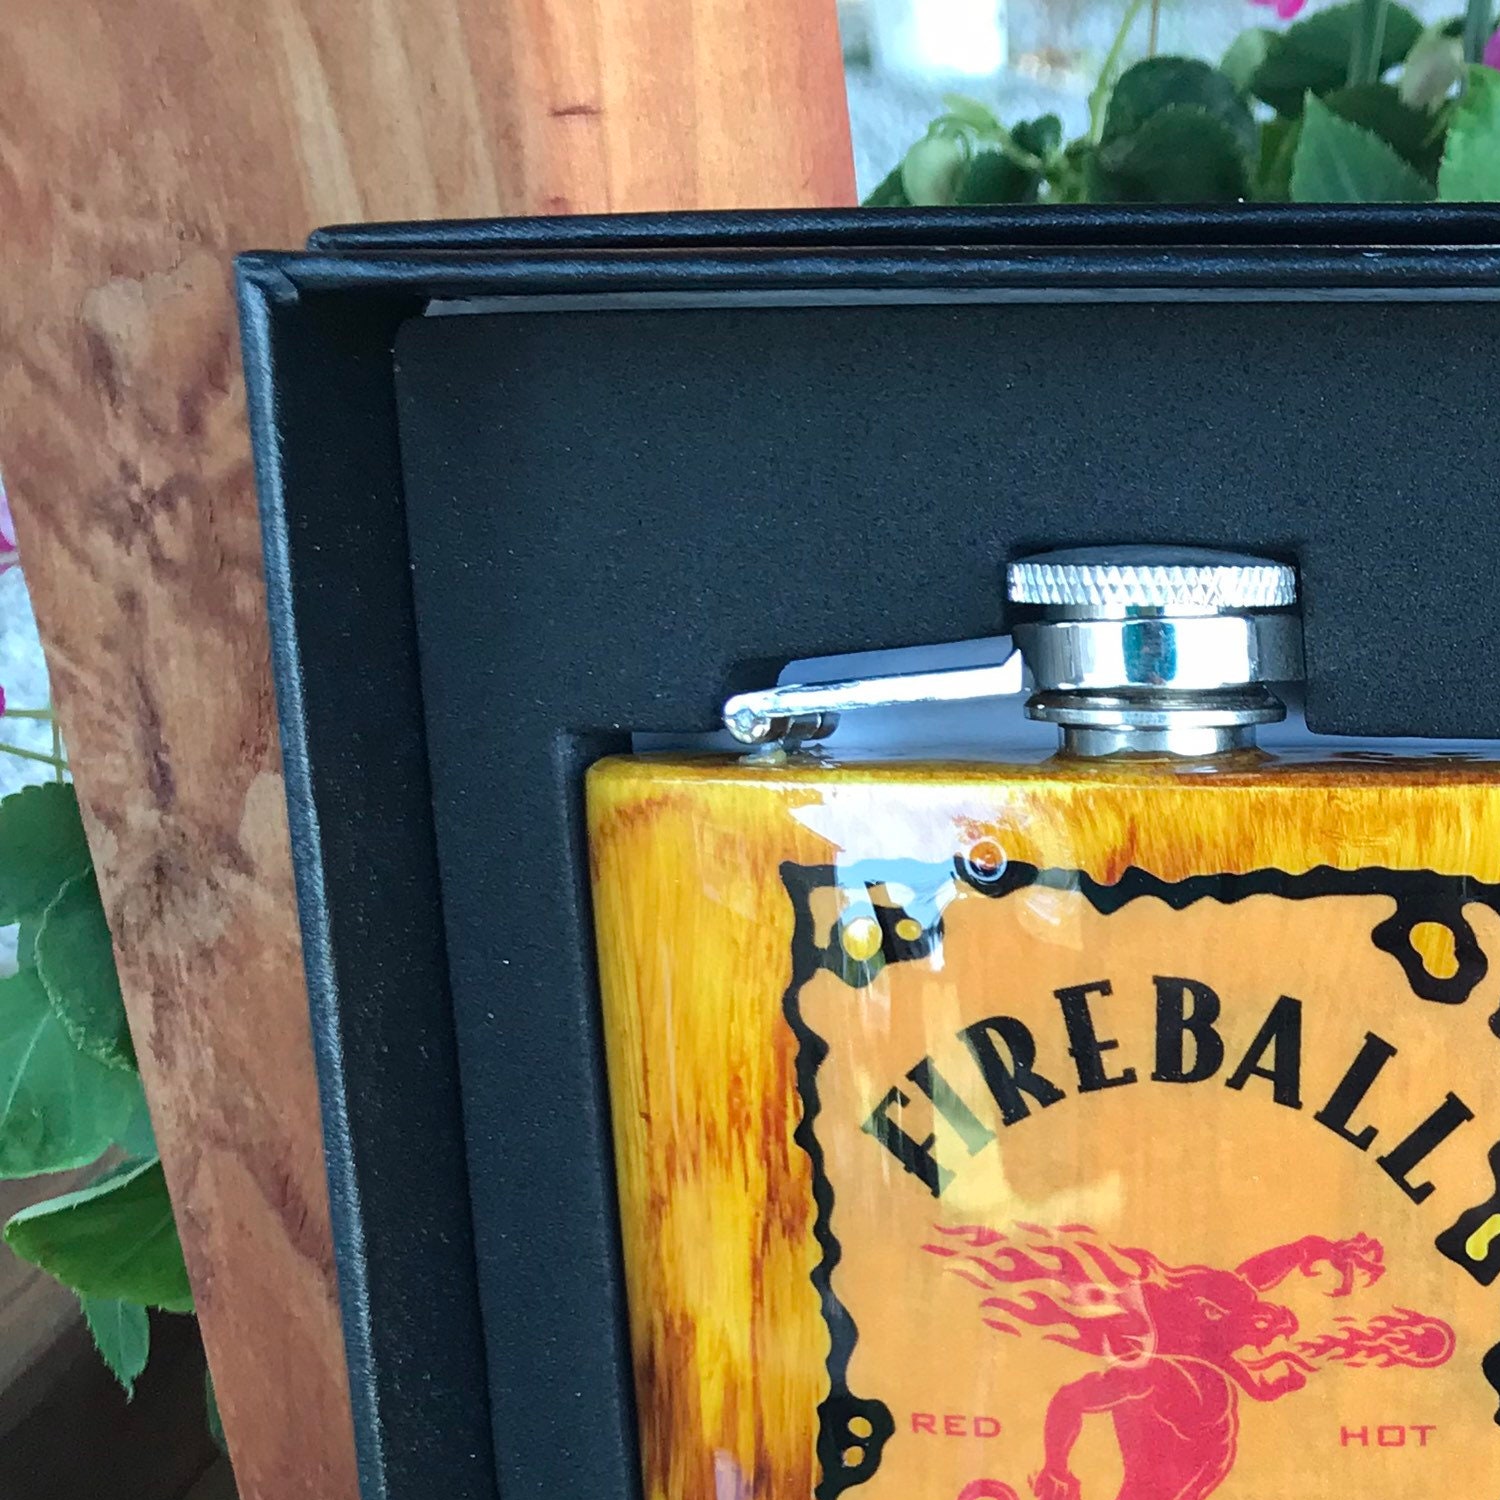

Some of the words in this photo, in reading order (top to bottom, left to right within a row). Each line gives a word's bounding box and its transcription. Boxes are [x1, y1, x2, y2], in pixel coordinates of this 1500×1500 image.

[862, 975, 1475, 1205] FIREBALL
[911, 1413, 1001, 1438] RED
[1340, 1424, 1437, 1447] HOT
